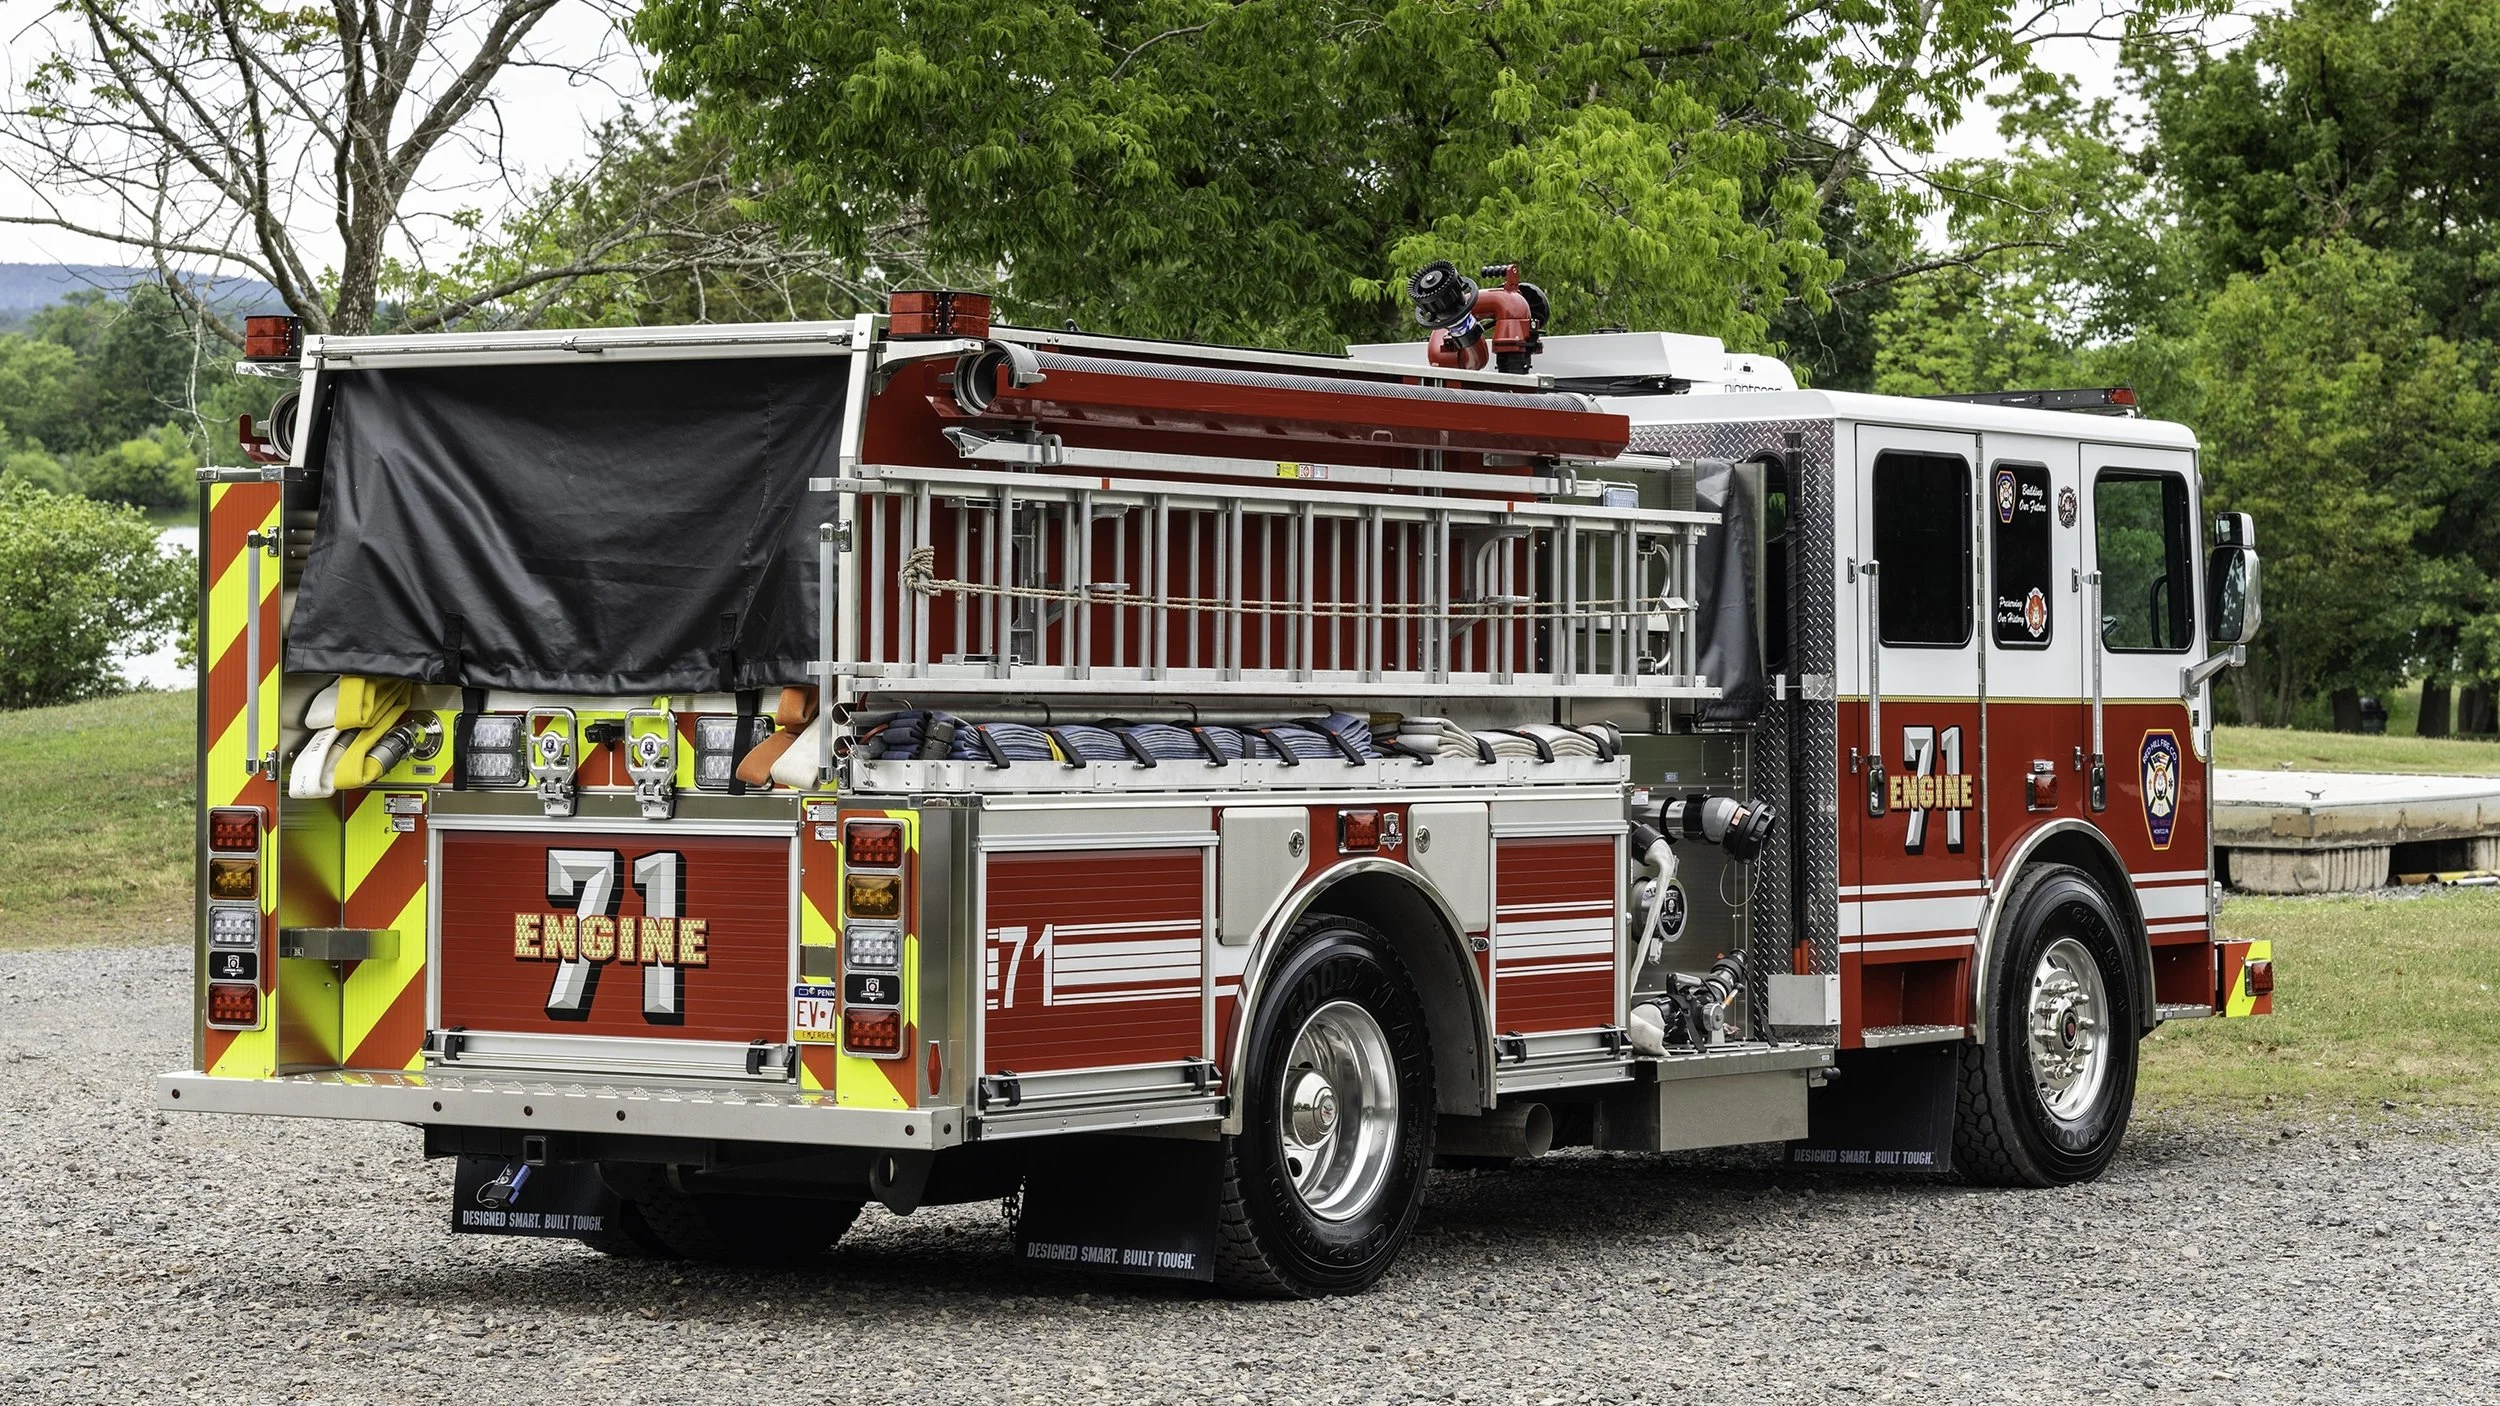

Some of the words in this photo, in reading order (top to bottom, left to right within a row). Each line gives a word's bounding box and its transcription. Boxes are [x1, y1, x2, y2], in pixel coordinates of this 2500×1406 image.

[2021, 483, 2043, 500] Building
[2019, 499, 2029, 511] Our
[2029, 500, 2047, 514] Future
[1997, 612, 2007, 623] Our
[2007, 612, 2025, 626] History
[2142, 747, 2151, 764] RED
[2151, 739, 2160, 751] HILL
[2160, 739, 2170, 751] FIRE
[1889, 774, 1974, 811] ENGINE
[1903, 725, 1964, 855] 71
[514, 912, 709, 969] ENGINE
[546, 848, 686, 1023] 71
[999, 924, 1053, 1008] 71
[1794, 1149, 1837, 1163] DESIGNED
[1840, 1150, 1871, 1164] SMART.
[1875, 1151, 1900, 1165] BUILT
[463, 1210, 506, 1227] DESIGNED
[509, 1212, 541, 1229] SMART.
[544, 1214, 571, 1230] BUILT
[572, 1215, 603, 1231] TOUGH.
[1027, 1242, 1078, 1261] DESIGNED
[1081, 1246, 1119, 1264] SMART.
[1123, 1249, 1155, 1267] BUILT
[1156, 1251, 1195, 1270] TOUGH.
